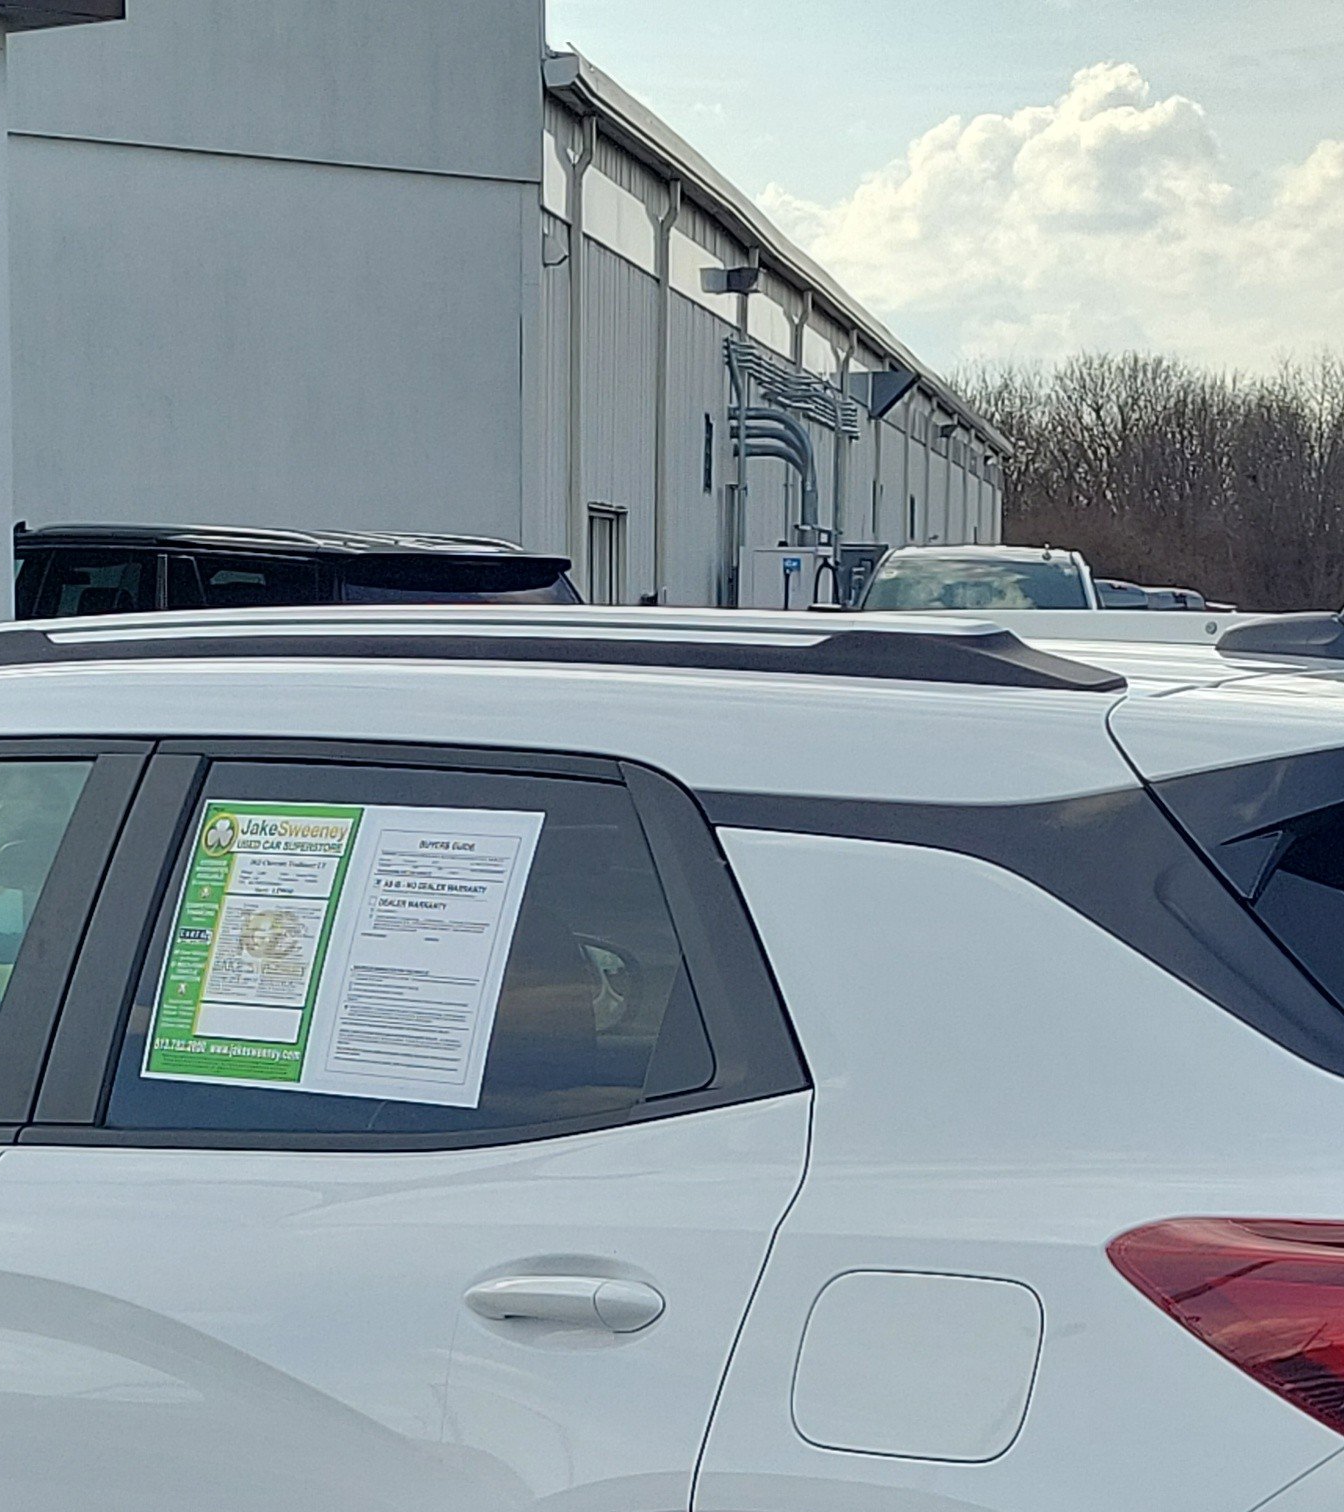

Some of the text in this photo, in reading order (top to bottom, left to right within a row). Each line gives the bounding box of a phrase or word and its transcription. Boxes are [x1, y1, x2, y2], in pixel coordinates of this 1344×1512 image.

[241, 819, 348, 842] JakeSweeney
[262, 841, 280, 851] CAR
[282, 842, 343, 854] SUPERSTORE
